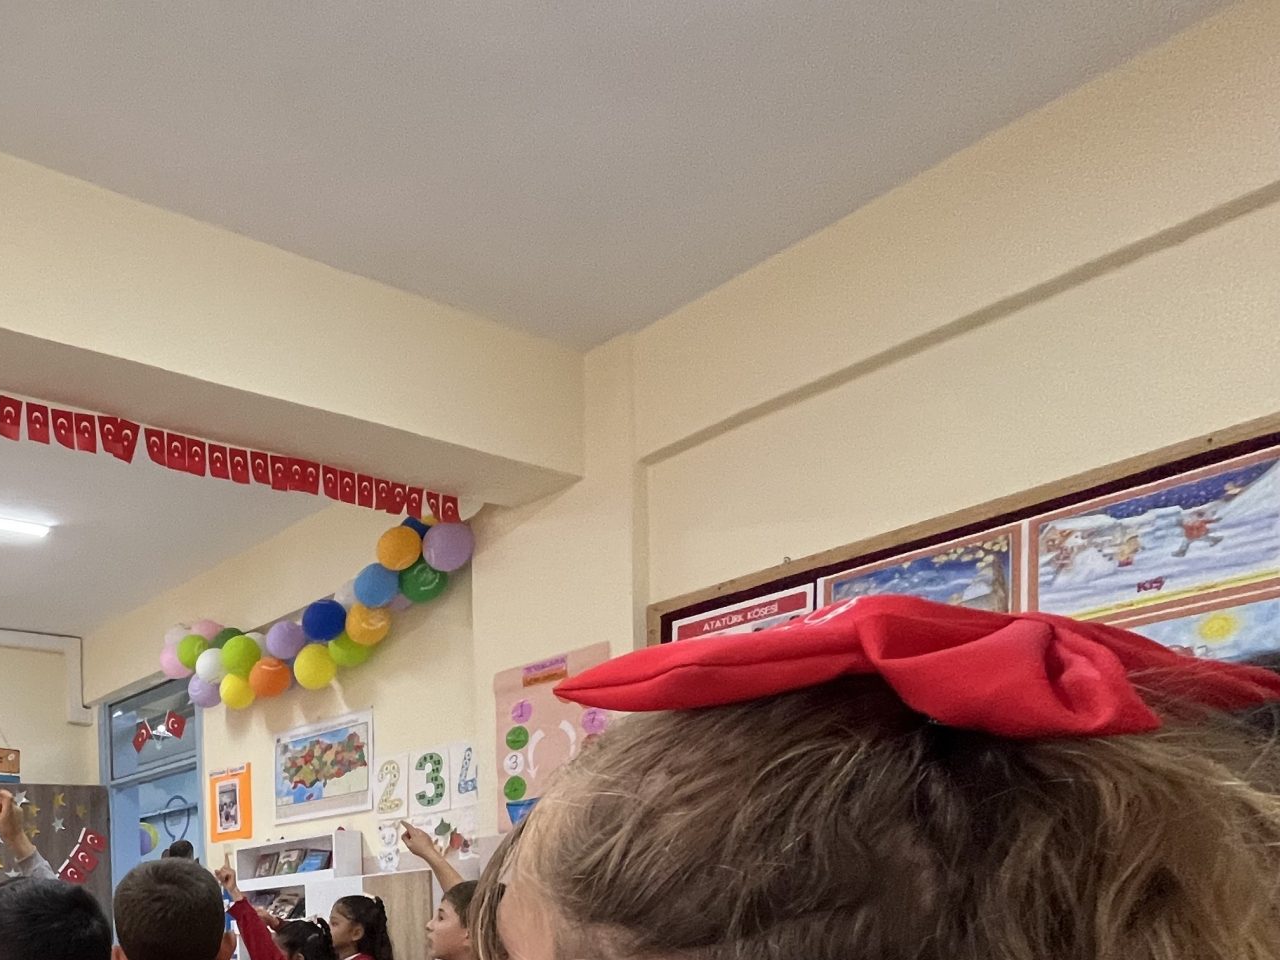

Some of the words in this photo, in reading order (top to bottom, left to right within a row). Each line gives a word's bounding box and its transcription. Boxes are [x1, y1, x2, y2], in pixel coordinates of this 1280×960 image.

[702, 612, 745, 632] ATATÜRK
[415, 752, 446, 807] 3
[509, 754, 519, 770] 3
[378, 759, 403, 814] 2
